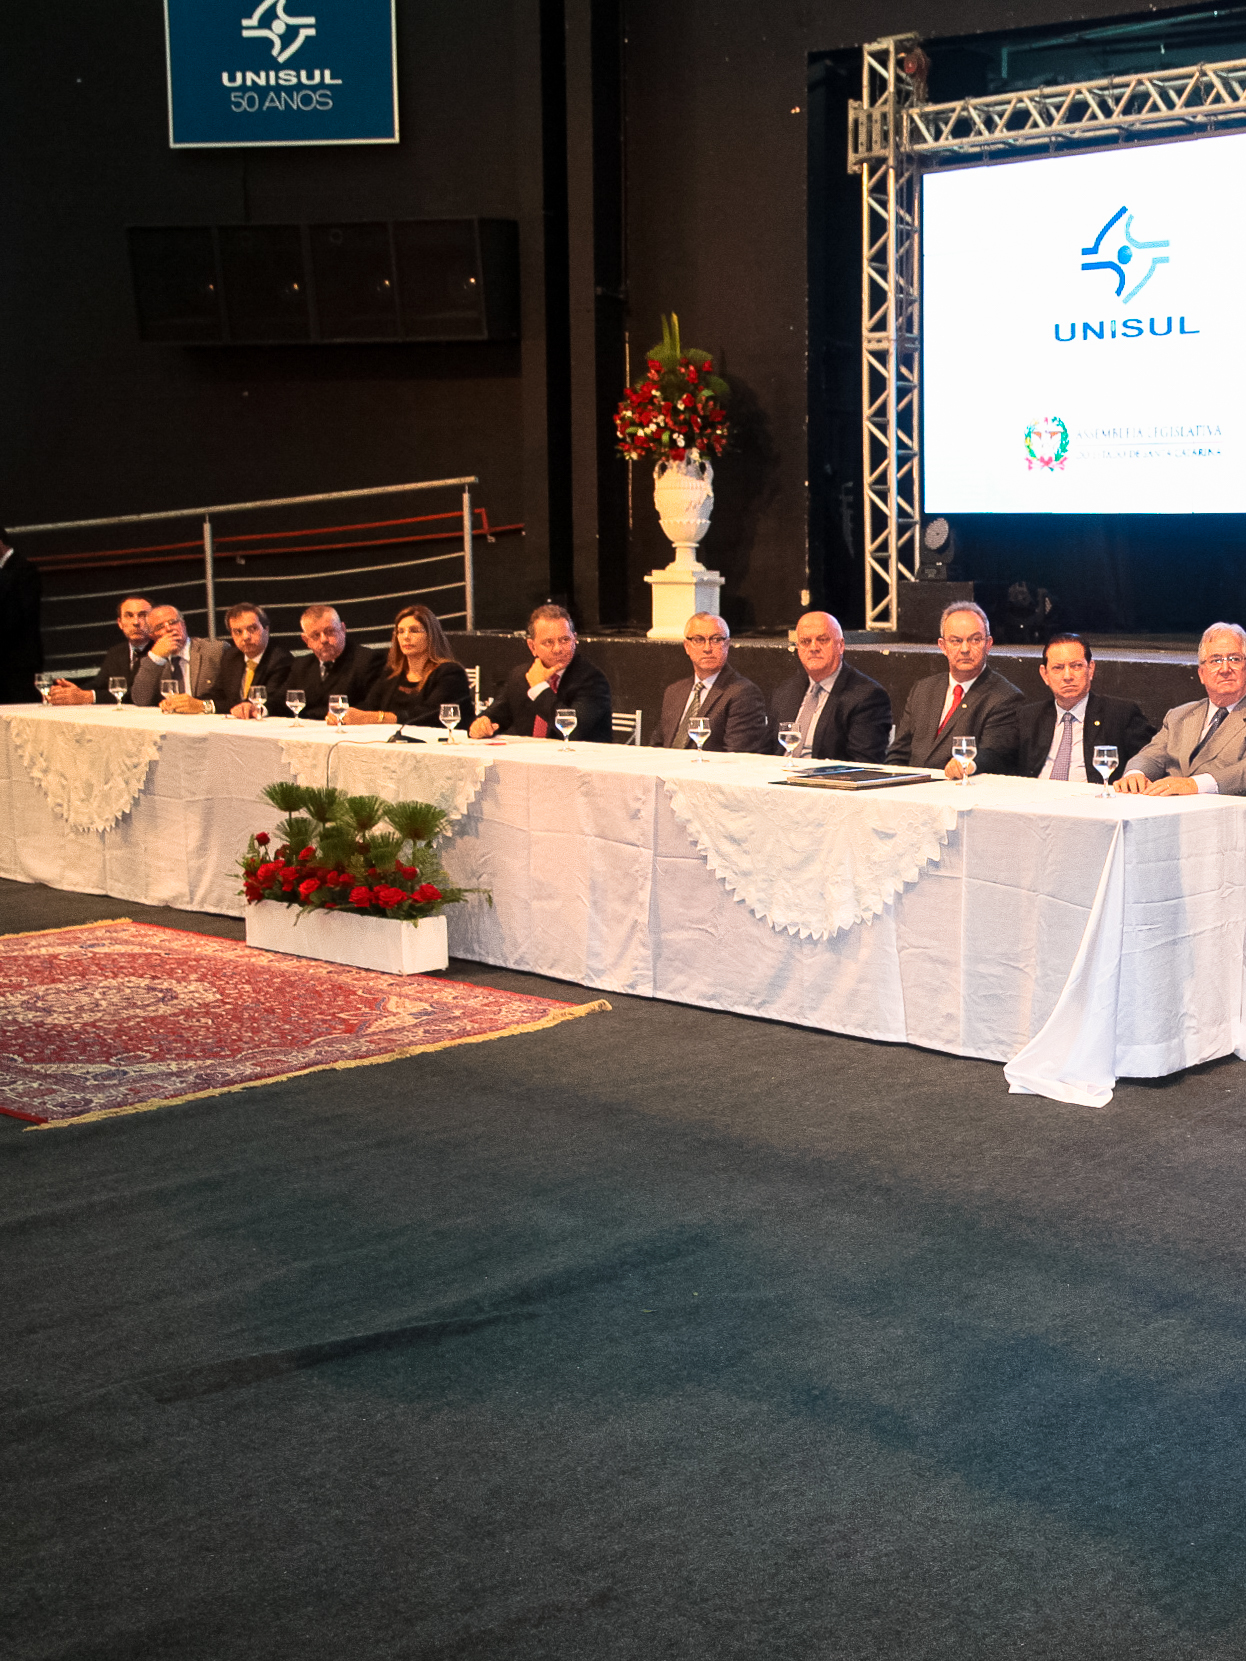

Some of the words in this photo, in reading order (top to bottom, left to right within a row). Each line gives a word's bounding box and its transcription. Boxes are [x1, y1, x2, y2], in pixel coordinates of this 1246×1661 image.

[222, 69, 343, 87] UNISUL
[230, 91, 259, 112] 50
[262, 89, 334, 111] ANOS
[1054, 316, 1200, 342] UNISUL
